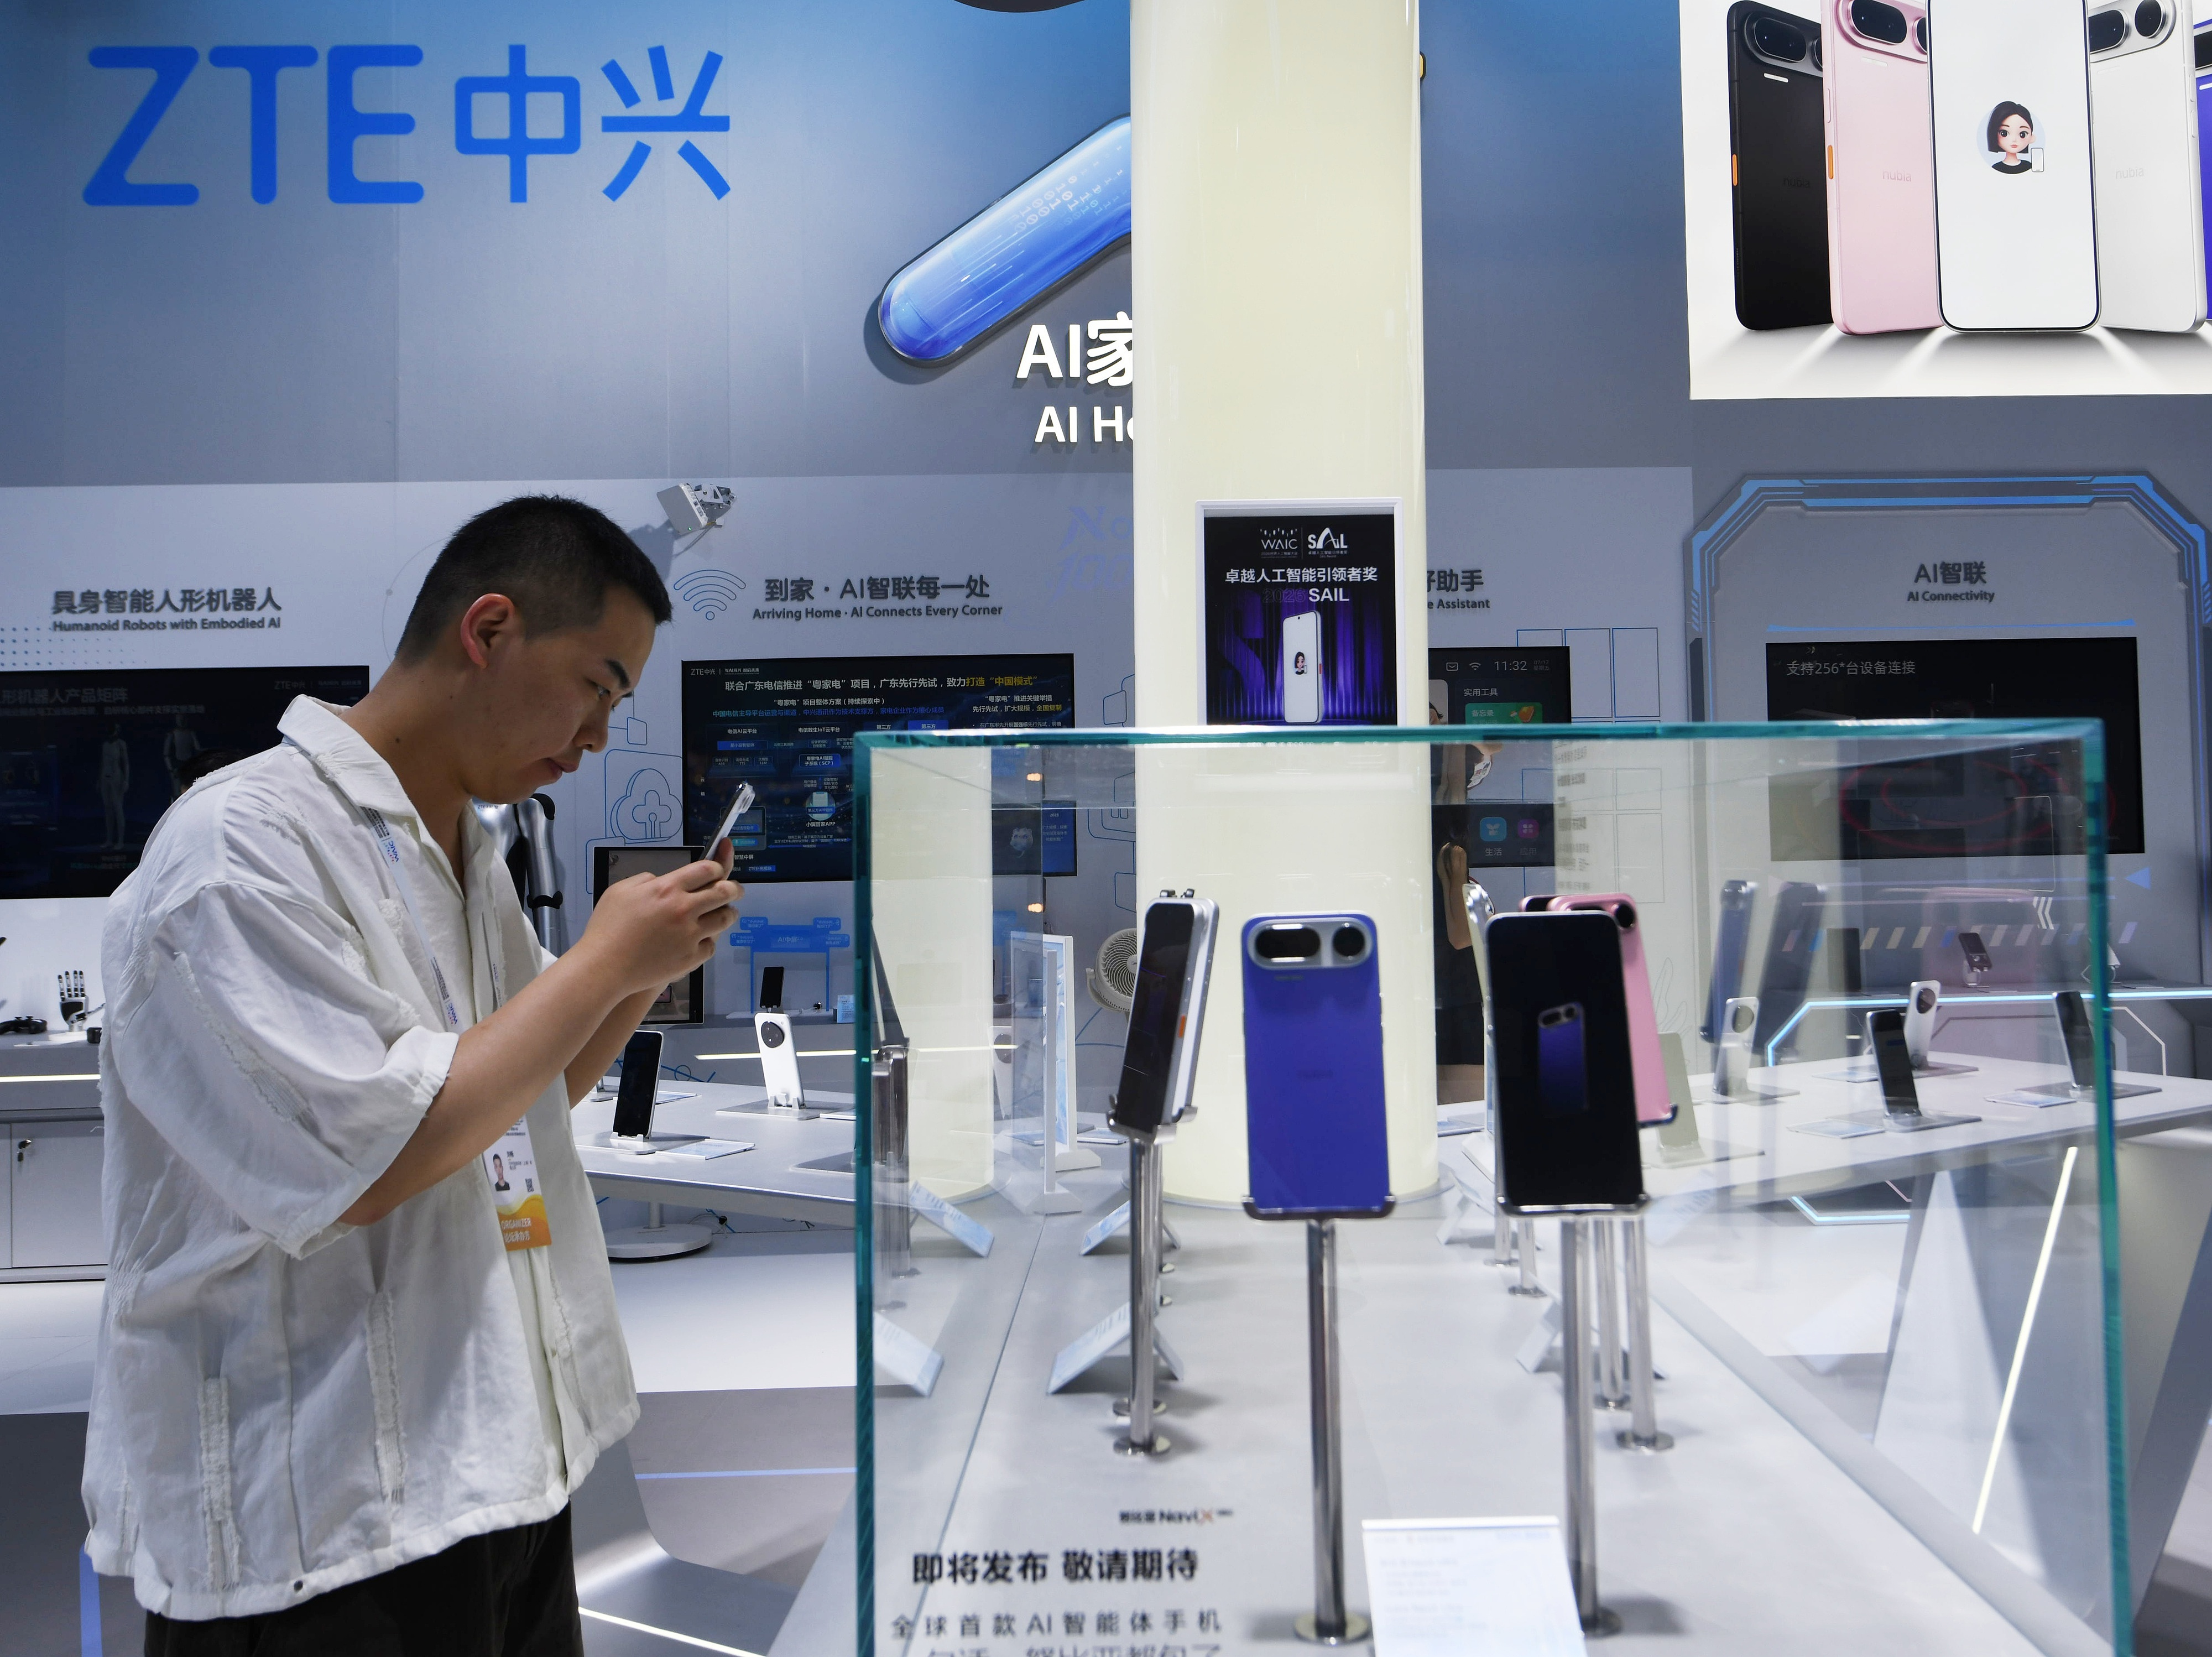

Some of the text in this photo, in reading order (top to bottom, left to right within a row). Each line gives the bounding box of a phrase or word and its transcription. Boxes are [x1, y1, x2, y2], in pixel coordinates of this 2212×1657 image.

[82, 44, 731, 206] ZTE 中兴
[1882, 169, 1912, 182] nubia
[2115, 166, 2145, 180] nubia
[1782, 175, 1811, 189] nubia
[1035, 407, 1077, 442] AI
[1261, 539, 1298, 549] WAIC
[1225, 566, 1378, 583] 卓越人工智能引领者奖
[1914, 561, 1987, 585] AI智联
[53, 587, 281, 614] 具身智能人形机器人
[1262, 588, 1349, 603] 2026 SAIL
[1907, 590, 1995, 603] AI Connectivity
[1437, 598, 1490, 609] Assistant
[753, 603, 1003, 621] Arriving Home AI Connects Every Corner
[53, 617, 281, 632] Humanoid Robots with Embodied AI
[1494, 661, 1527, 671] 11:32
[0, 687, 128, 704] 形机器人产品矩阵
[1464, 688, 1498, 697] 实用工具
[1485, 847, 1537, 856] 生活 应用
[912, 1549, 1198, 1584] 即将发布 敬请期待
